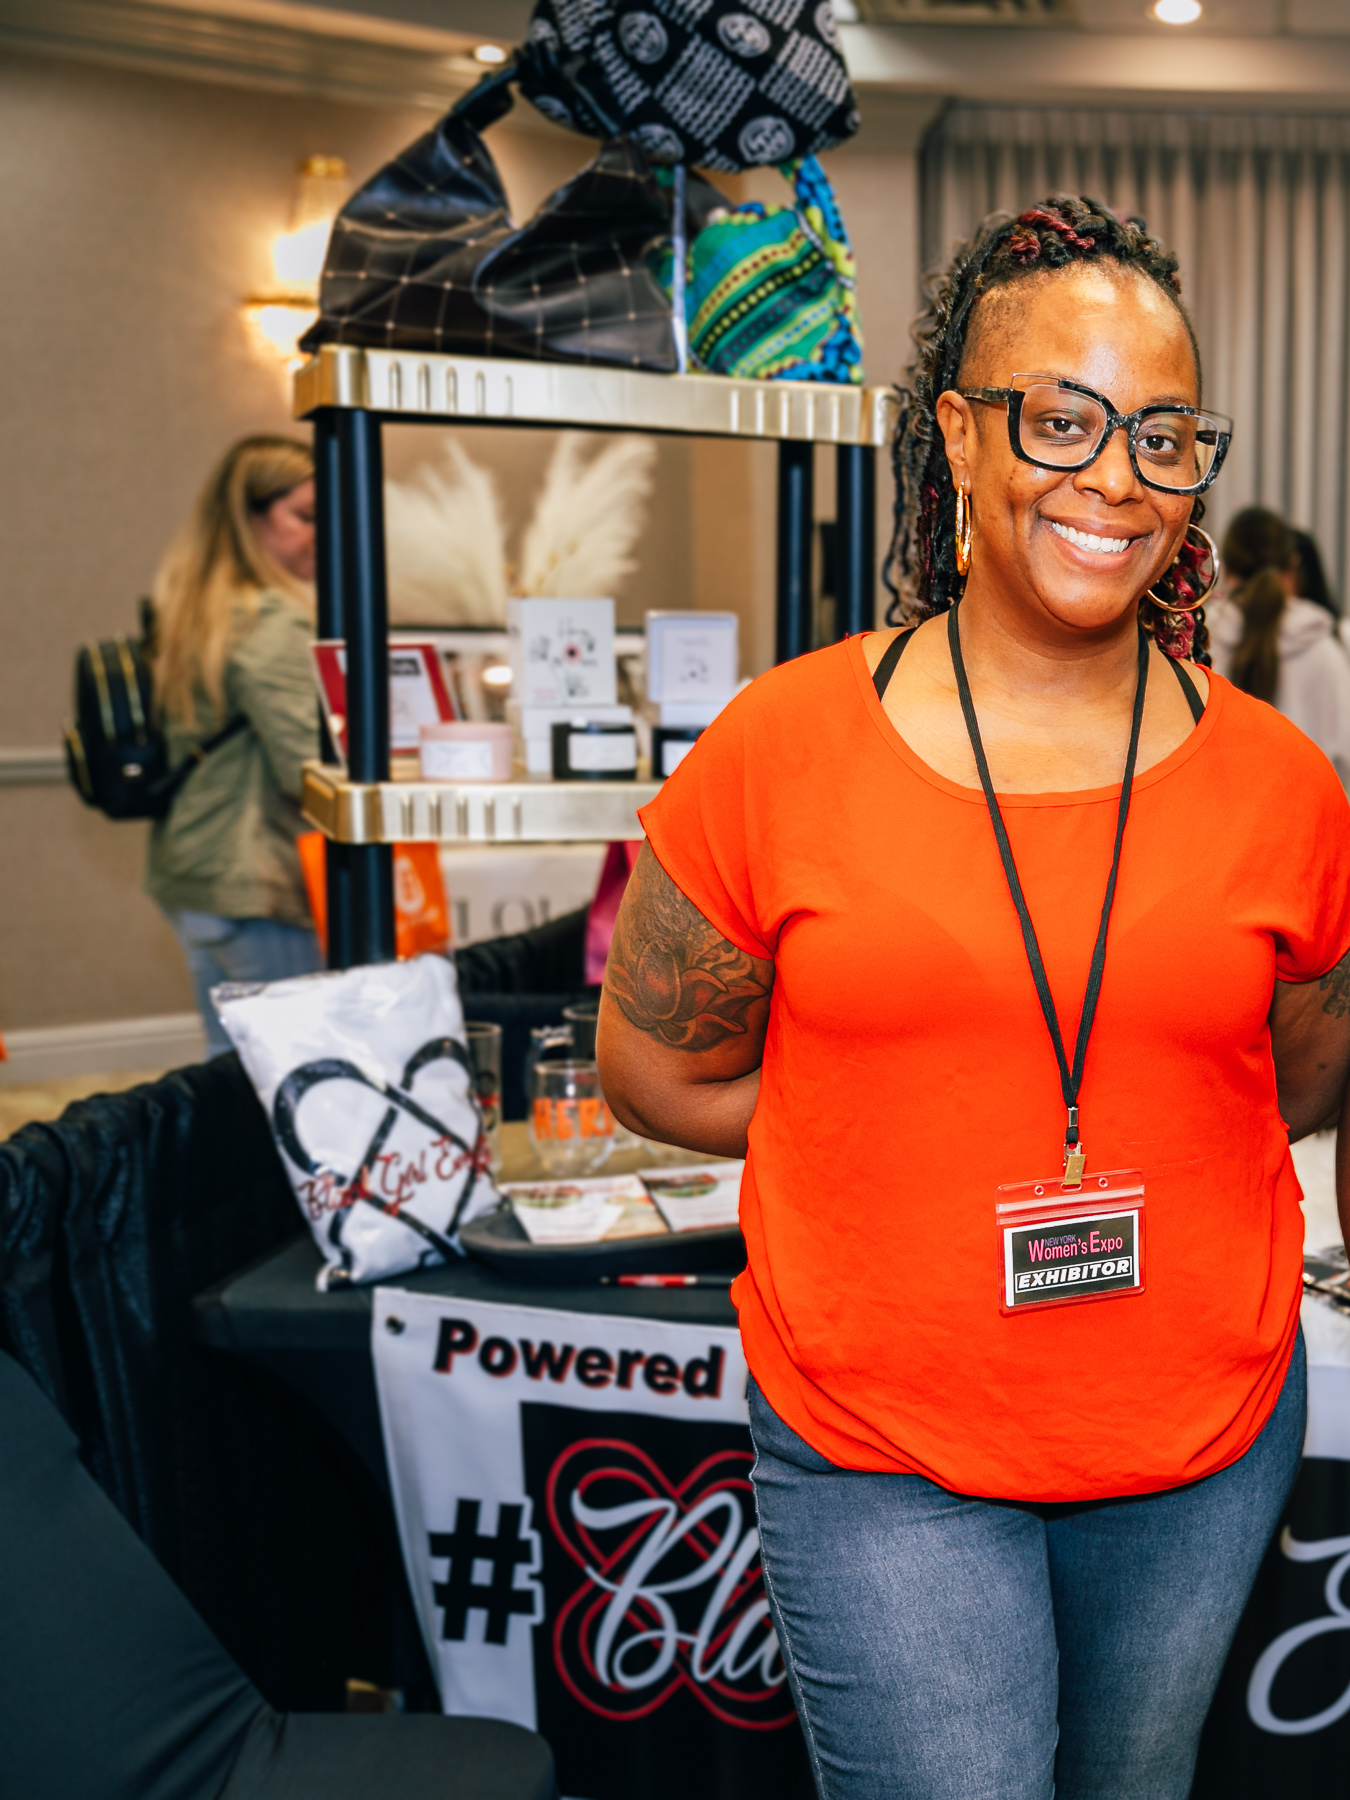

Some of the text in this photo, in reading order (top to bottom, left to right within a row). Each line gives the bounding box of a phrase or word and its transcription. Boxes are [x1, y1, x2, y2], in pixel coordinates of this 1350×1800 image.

[1028, 1231, 1124, 1263] Women's Expo
[1045, 1234, 1077, 1247] NEW YORK
[1018, 1260, 1130, 1289] EXHIBITOR
[433, 1317, 725, 1400] Powered
